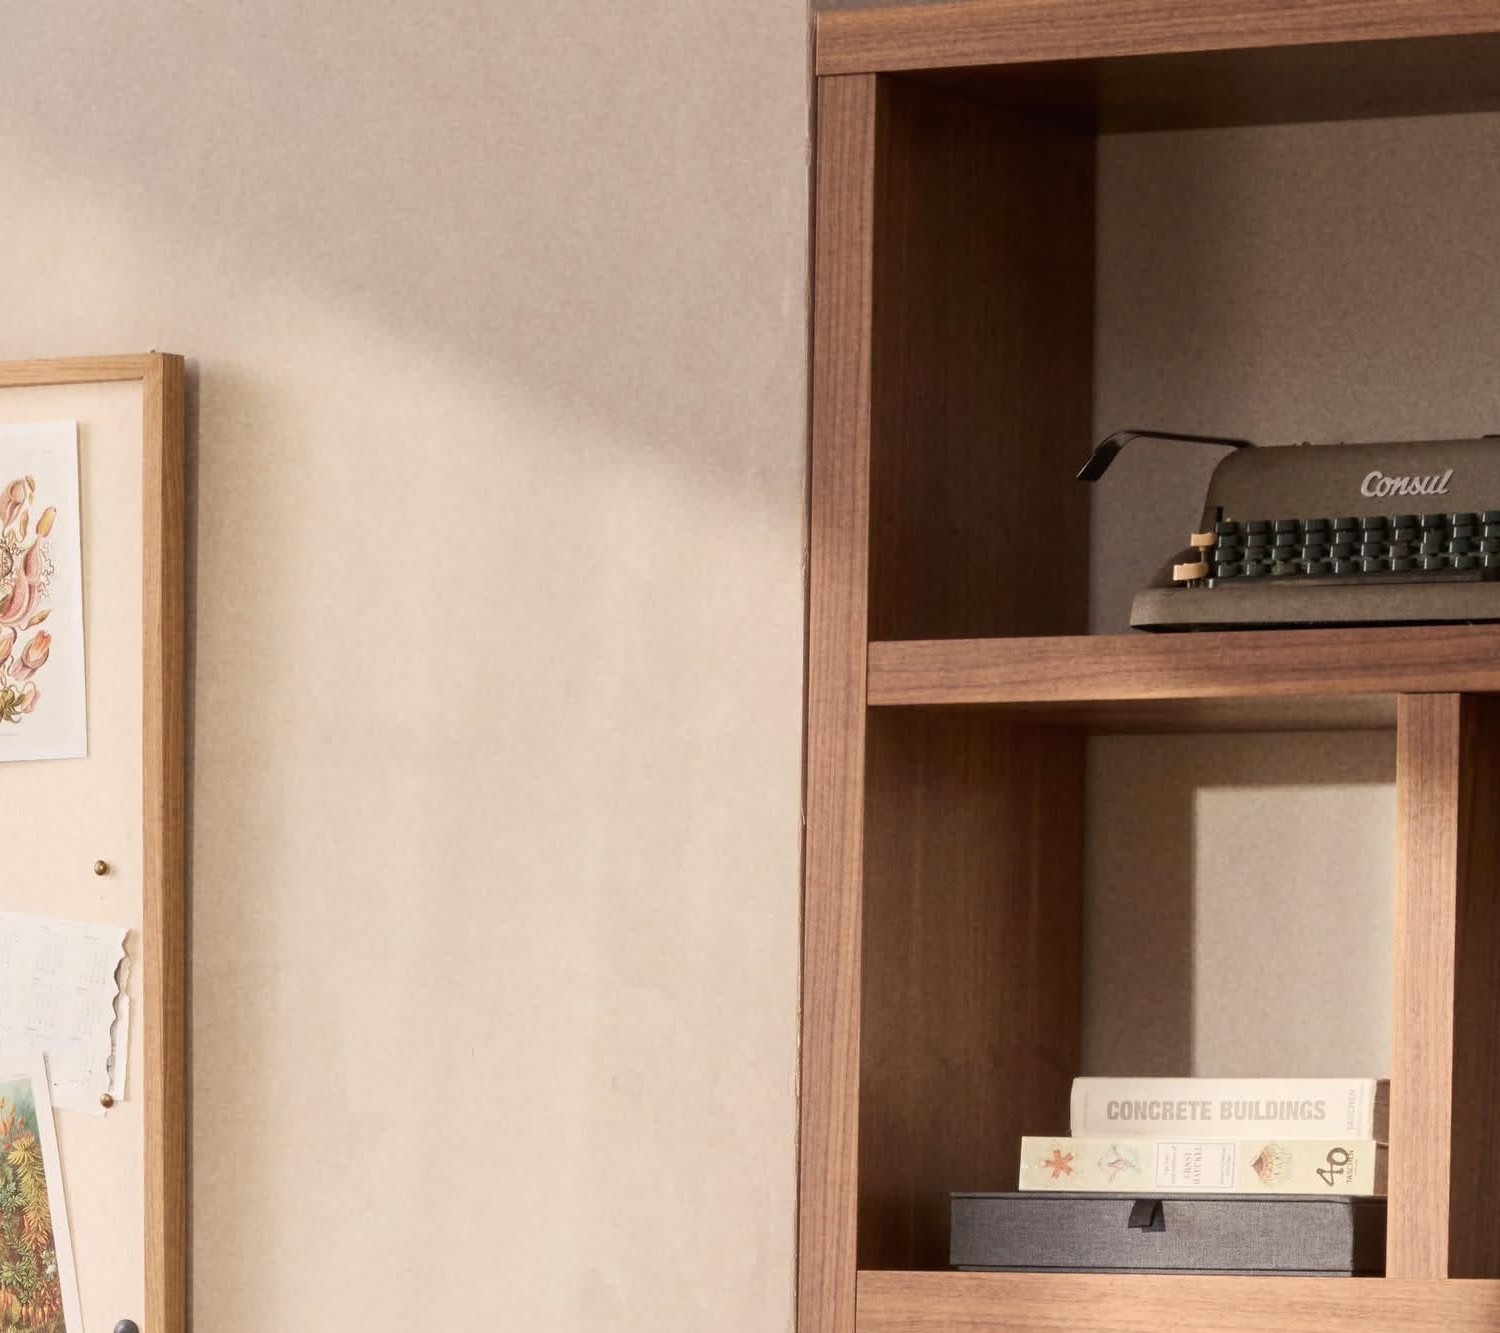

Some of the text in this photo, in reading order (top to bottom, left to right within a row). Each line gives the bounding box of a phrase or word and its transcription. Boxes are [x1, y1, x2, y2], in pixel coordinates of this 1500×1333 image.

[1360, 469, 1454, 497] Consul
[1106, 1100, 1326, 1121] CONCRETE BUILDINGS
